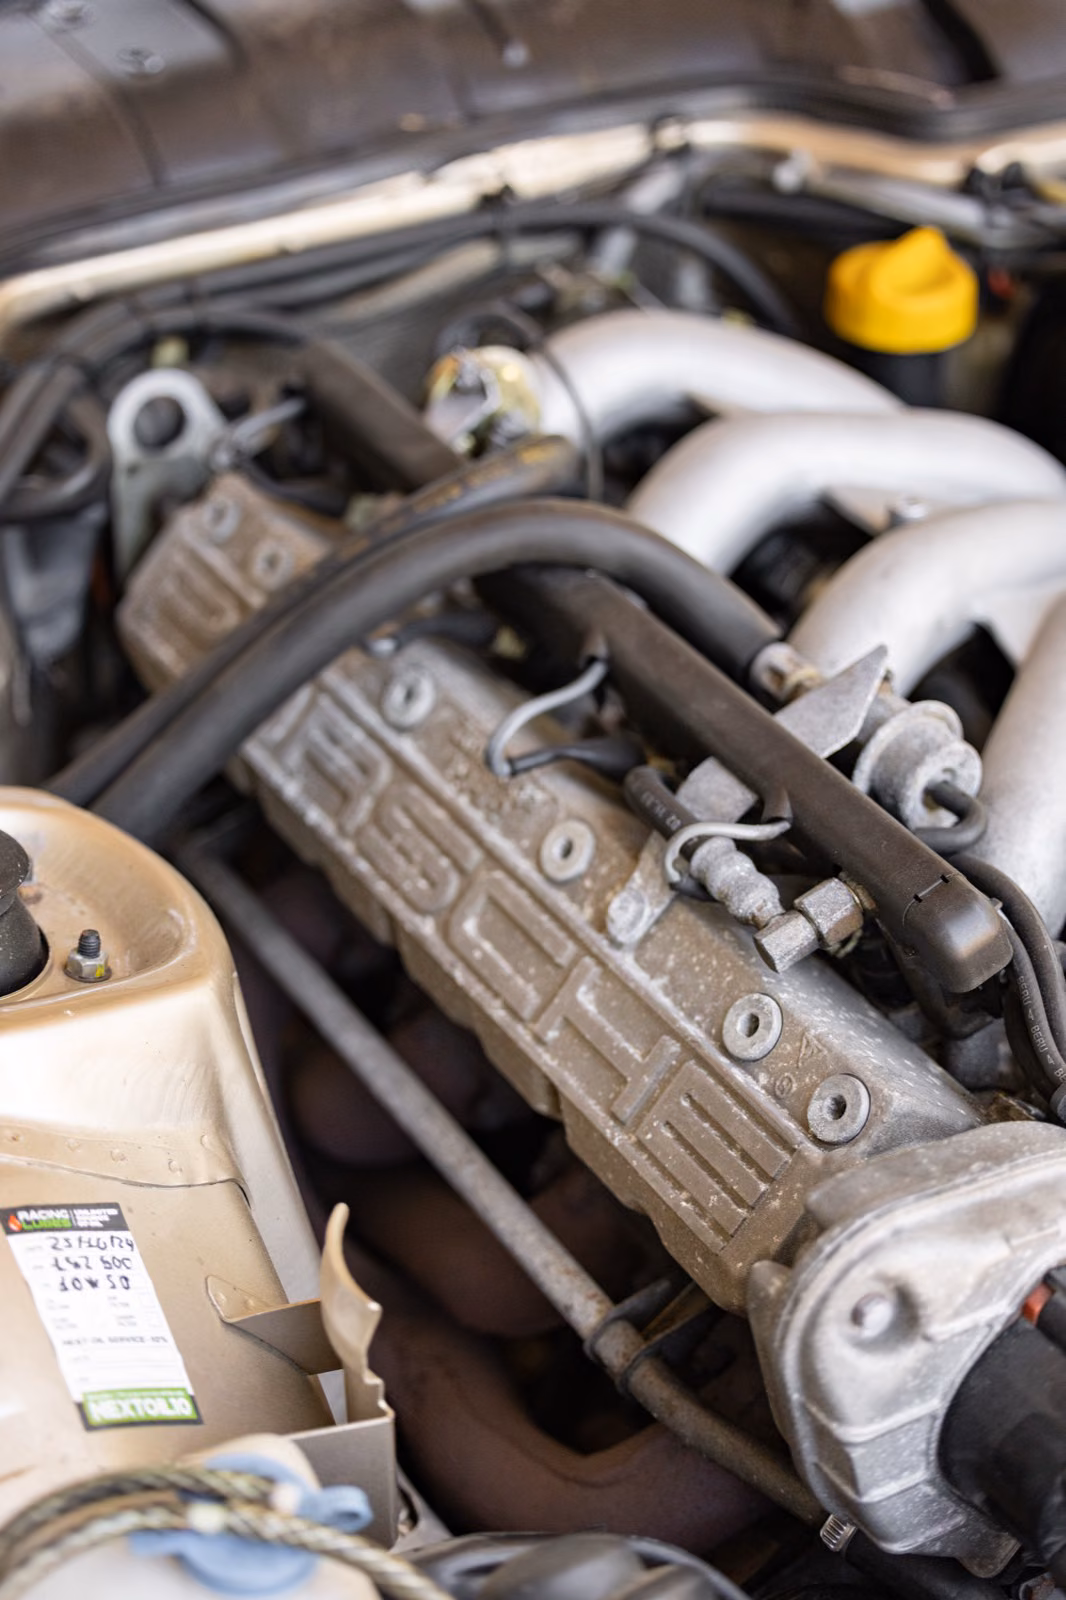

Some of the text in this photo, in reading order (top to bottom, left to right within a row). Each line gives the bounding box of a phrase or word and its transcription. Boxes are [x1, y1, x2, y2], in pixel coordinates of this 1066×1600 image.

[134, 548, 794, 1252] PRSCHE
[1016, 975, 1032, 1005] BERU
[1030, 1024, 1048, 1053] BERU
